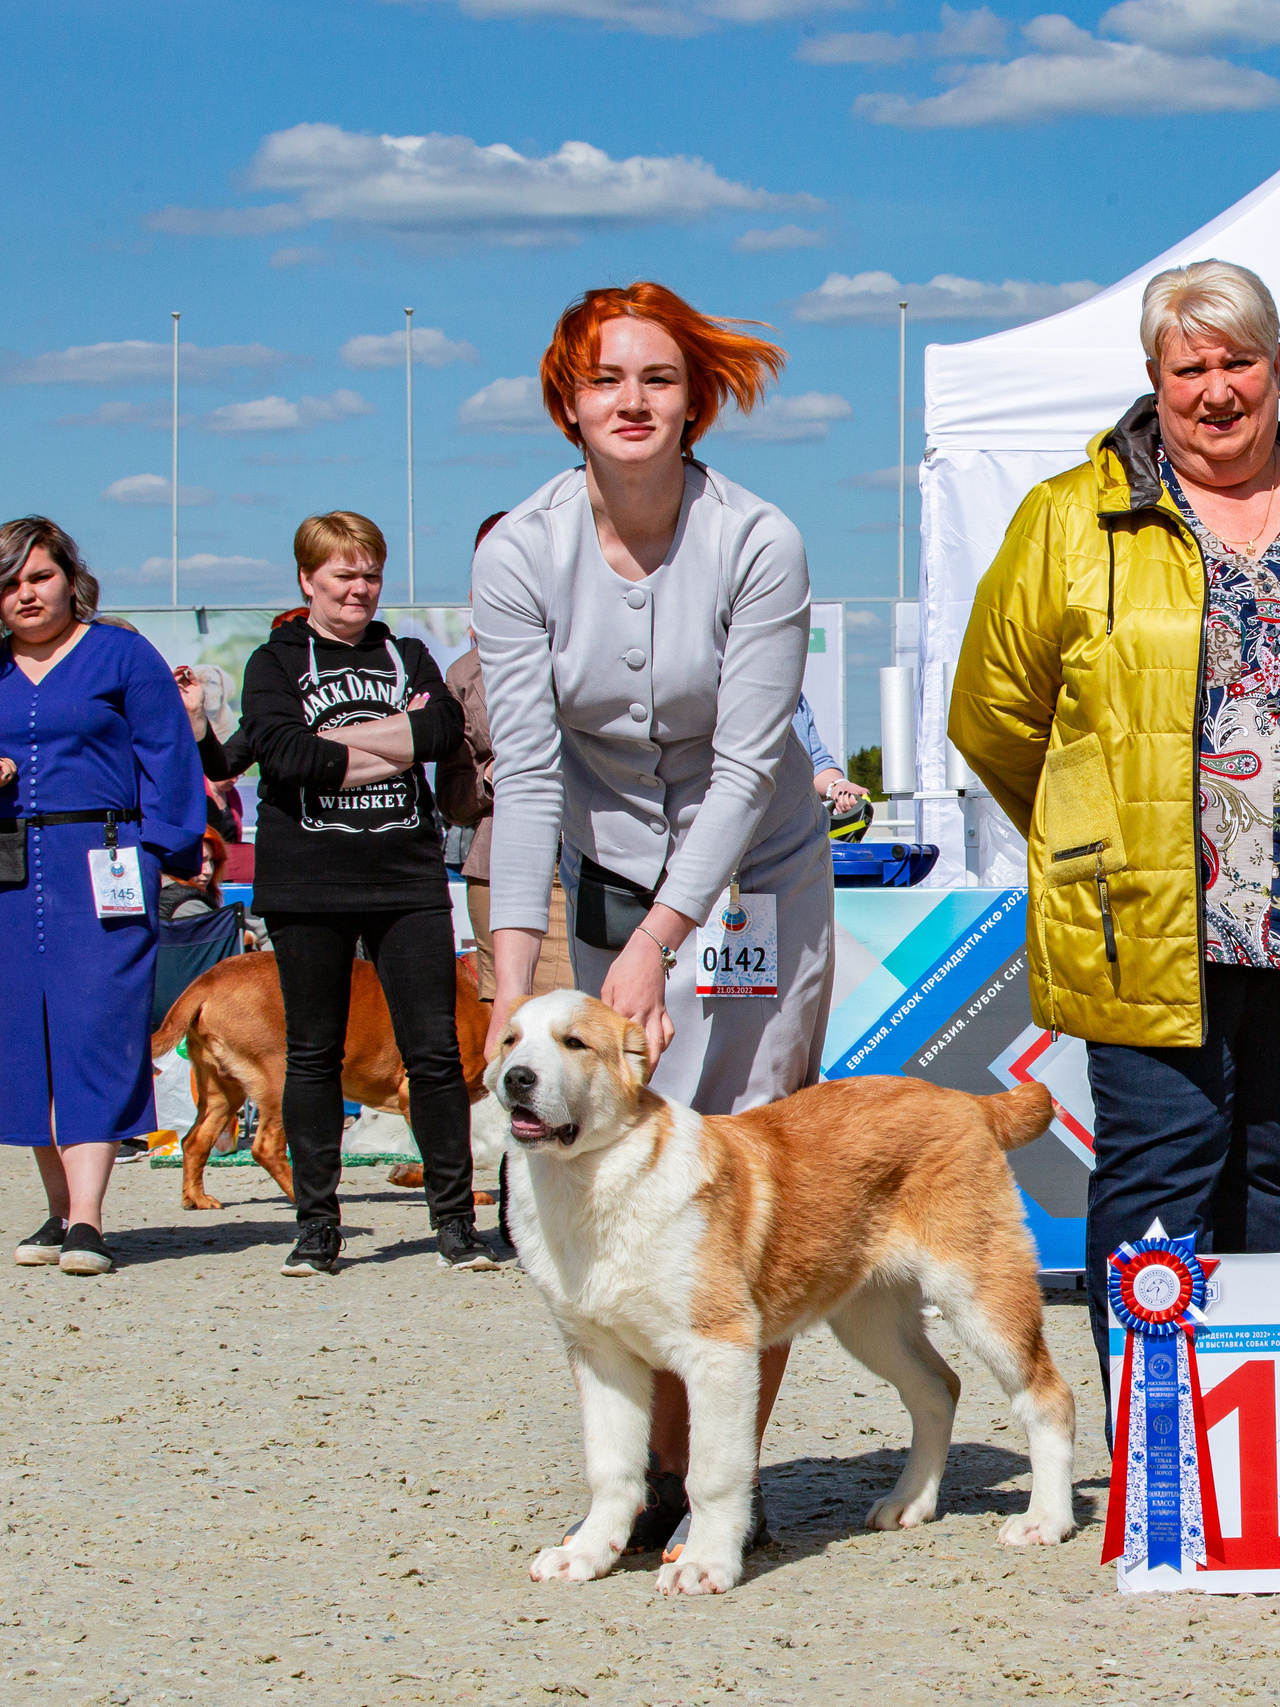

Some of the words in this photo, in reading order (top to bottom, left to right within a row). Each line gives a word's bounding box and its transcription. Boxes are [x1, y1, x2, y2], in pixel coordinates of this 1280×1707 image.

[303, 681, 350, 726] JACK
[318, 793, 408, 810] WHISKEY
[110, 888, 135, 900] 145
[703, 946, 766, 972] 0142
[845, 1026, 893, 1071] ЕВРАЗИЯ.
[890, 993, 924, 1026] КУБОК
[920, 932, 983, 994] ПРЕЗИДЕНТА
[979, 910, 1003, 934] РКФ
[1001, 887, 1028, 912] 2022
[716, 986, 753, 994] 21.05.2022
[918, 1019, 970, 1067] ЕВРАЗИЯ.
[967, 980, 1005, 1017] КУБОК
[1003, 958, 1025, 981] СНГ
[1245, 1340, 1269, 1348] СОБАК
